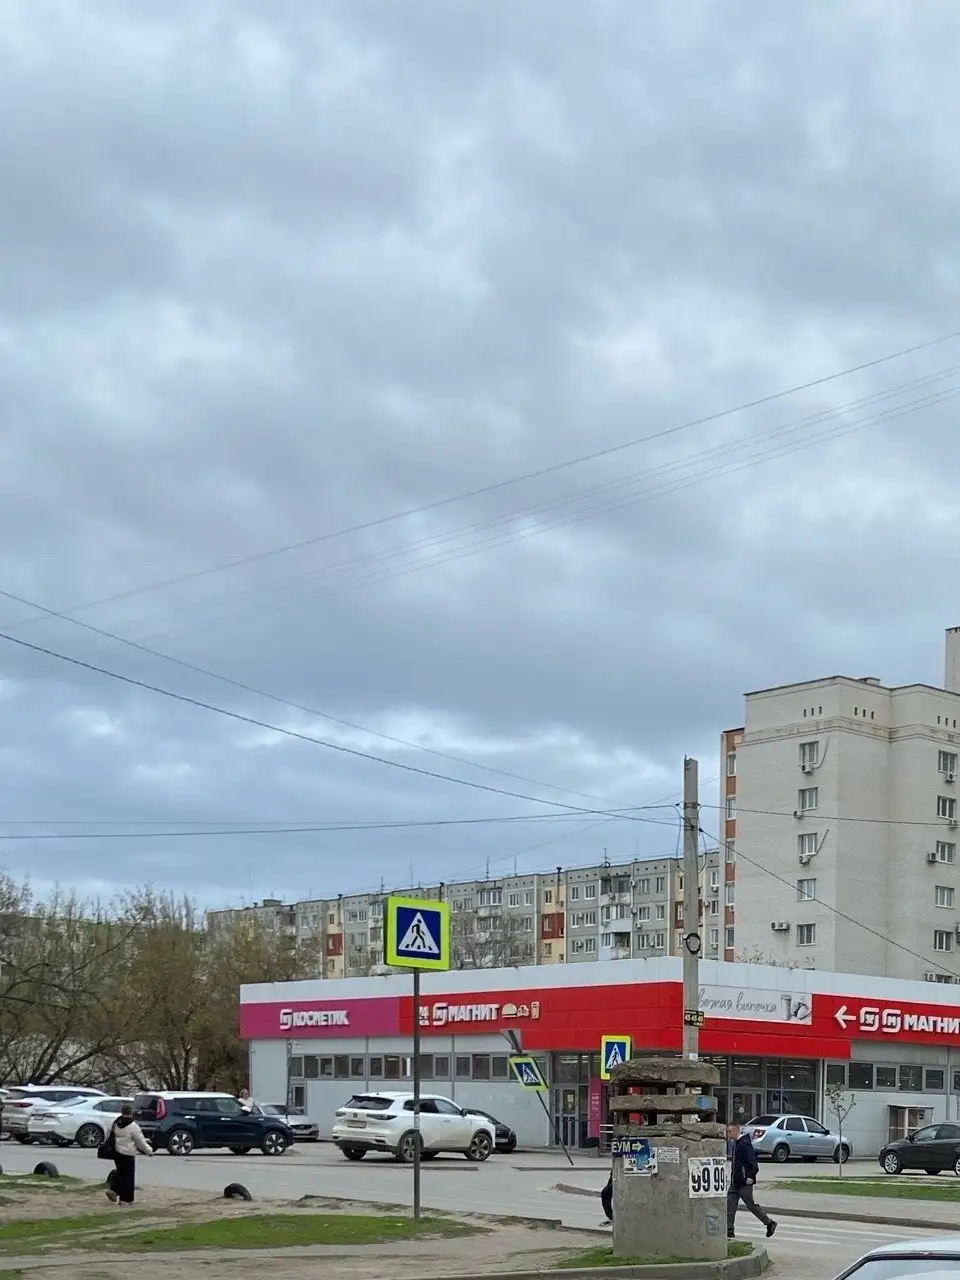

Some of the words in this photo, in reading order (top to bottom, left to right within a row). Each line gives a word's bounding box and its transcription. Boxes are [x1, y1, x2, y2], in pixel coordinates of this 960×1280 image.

[699, 988, 732, 1011] вежая
[292, 1010, 350, 1027] КОСМЕТИК
[448, 1003, 500, 1022] МАГНИТ
